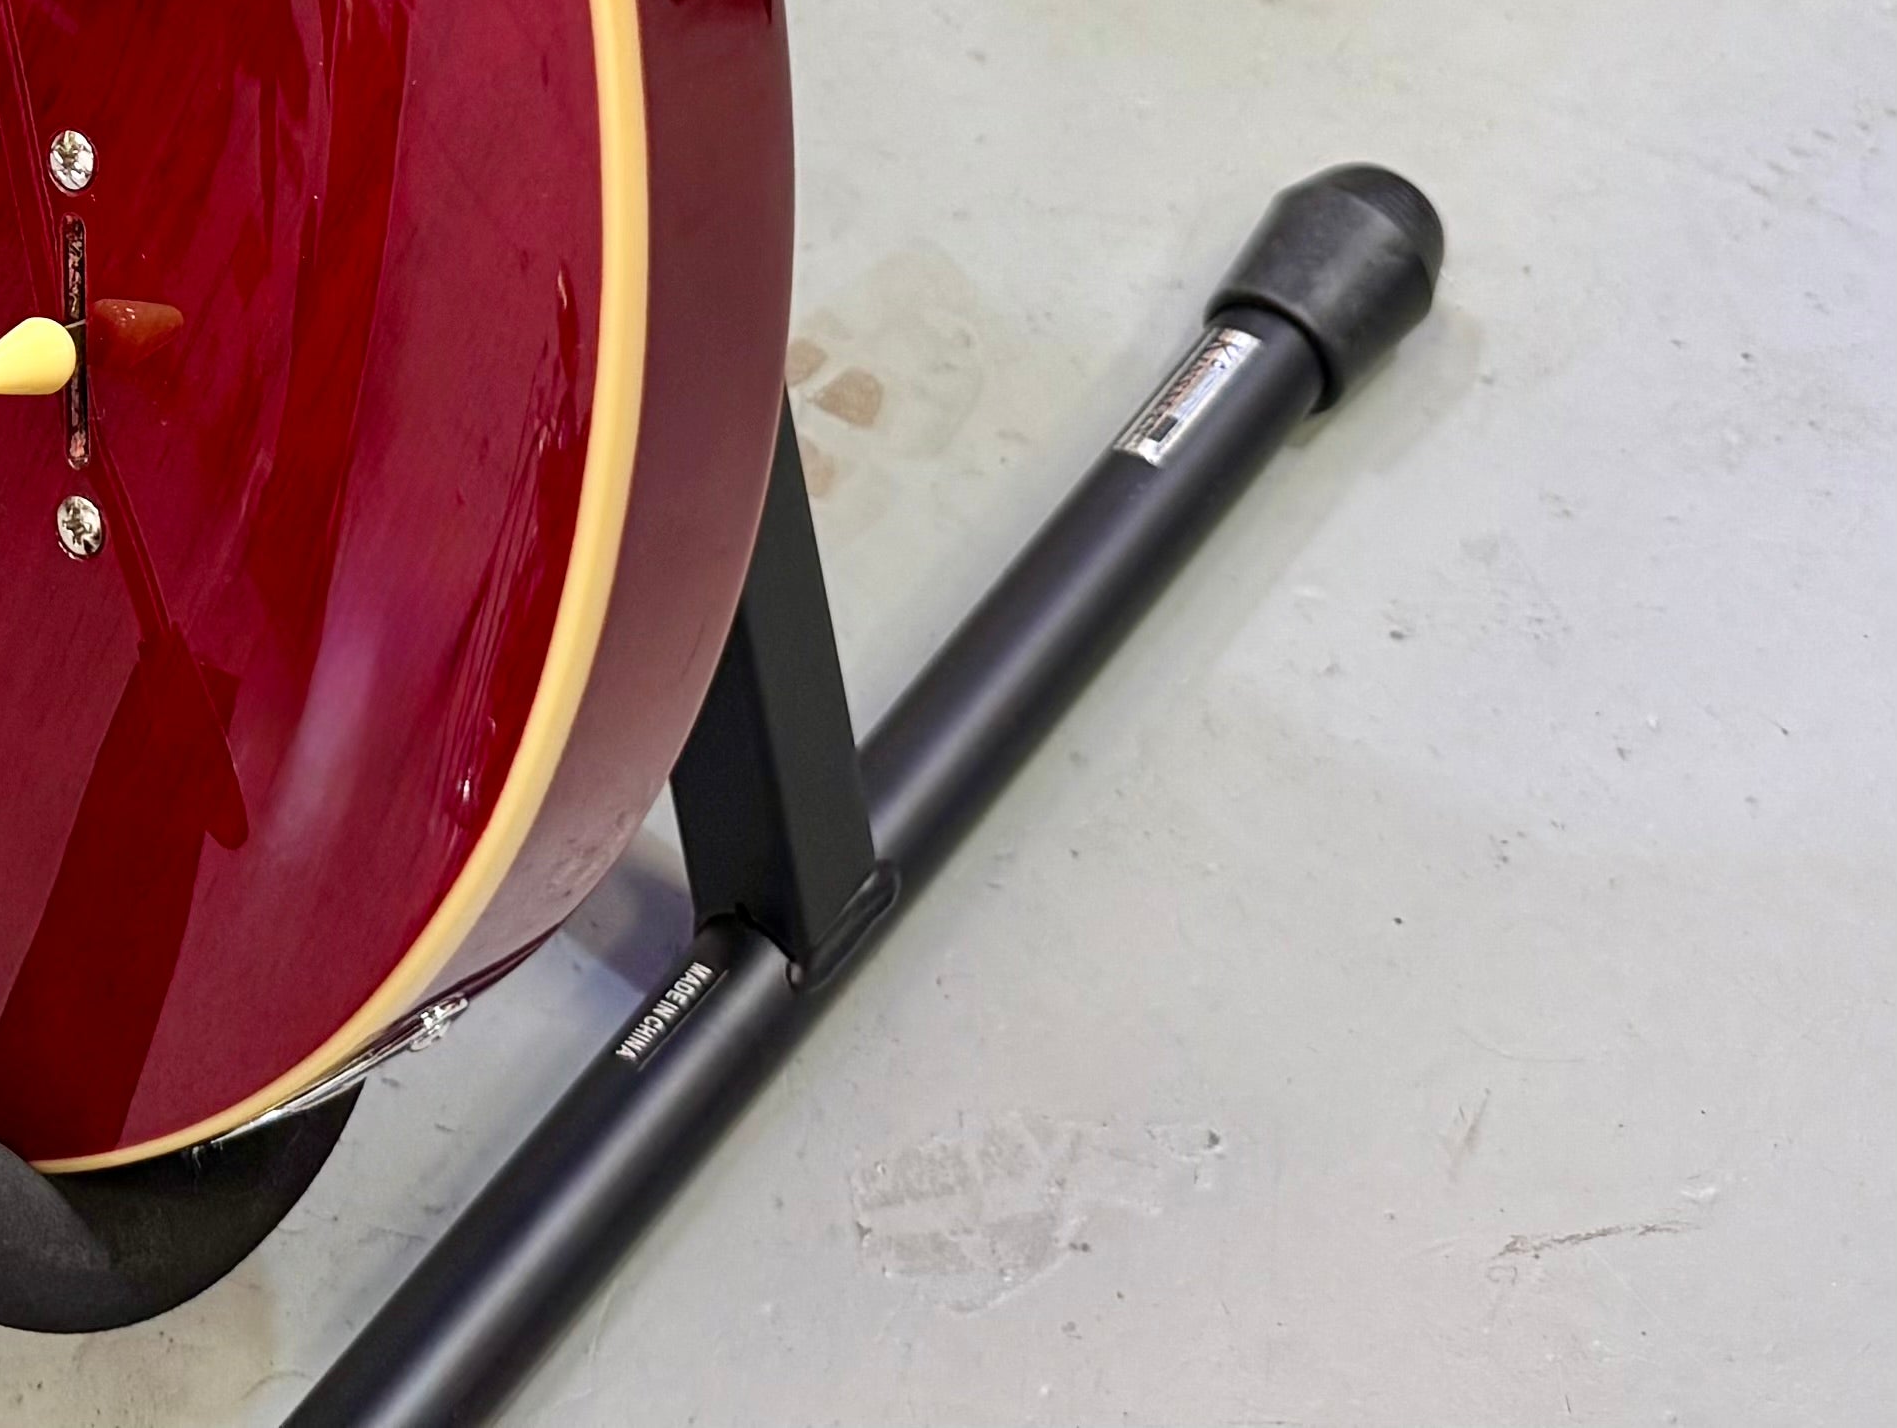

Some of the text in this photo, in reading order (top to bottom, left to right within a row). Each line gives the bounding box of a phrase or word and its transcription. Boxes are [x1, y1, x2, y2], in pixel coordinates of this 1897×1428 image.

[615, 962, 713, 1061] MADE IN CHINA
